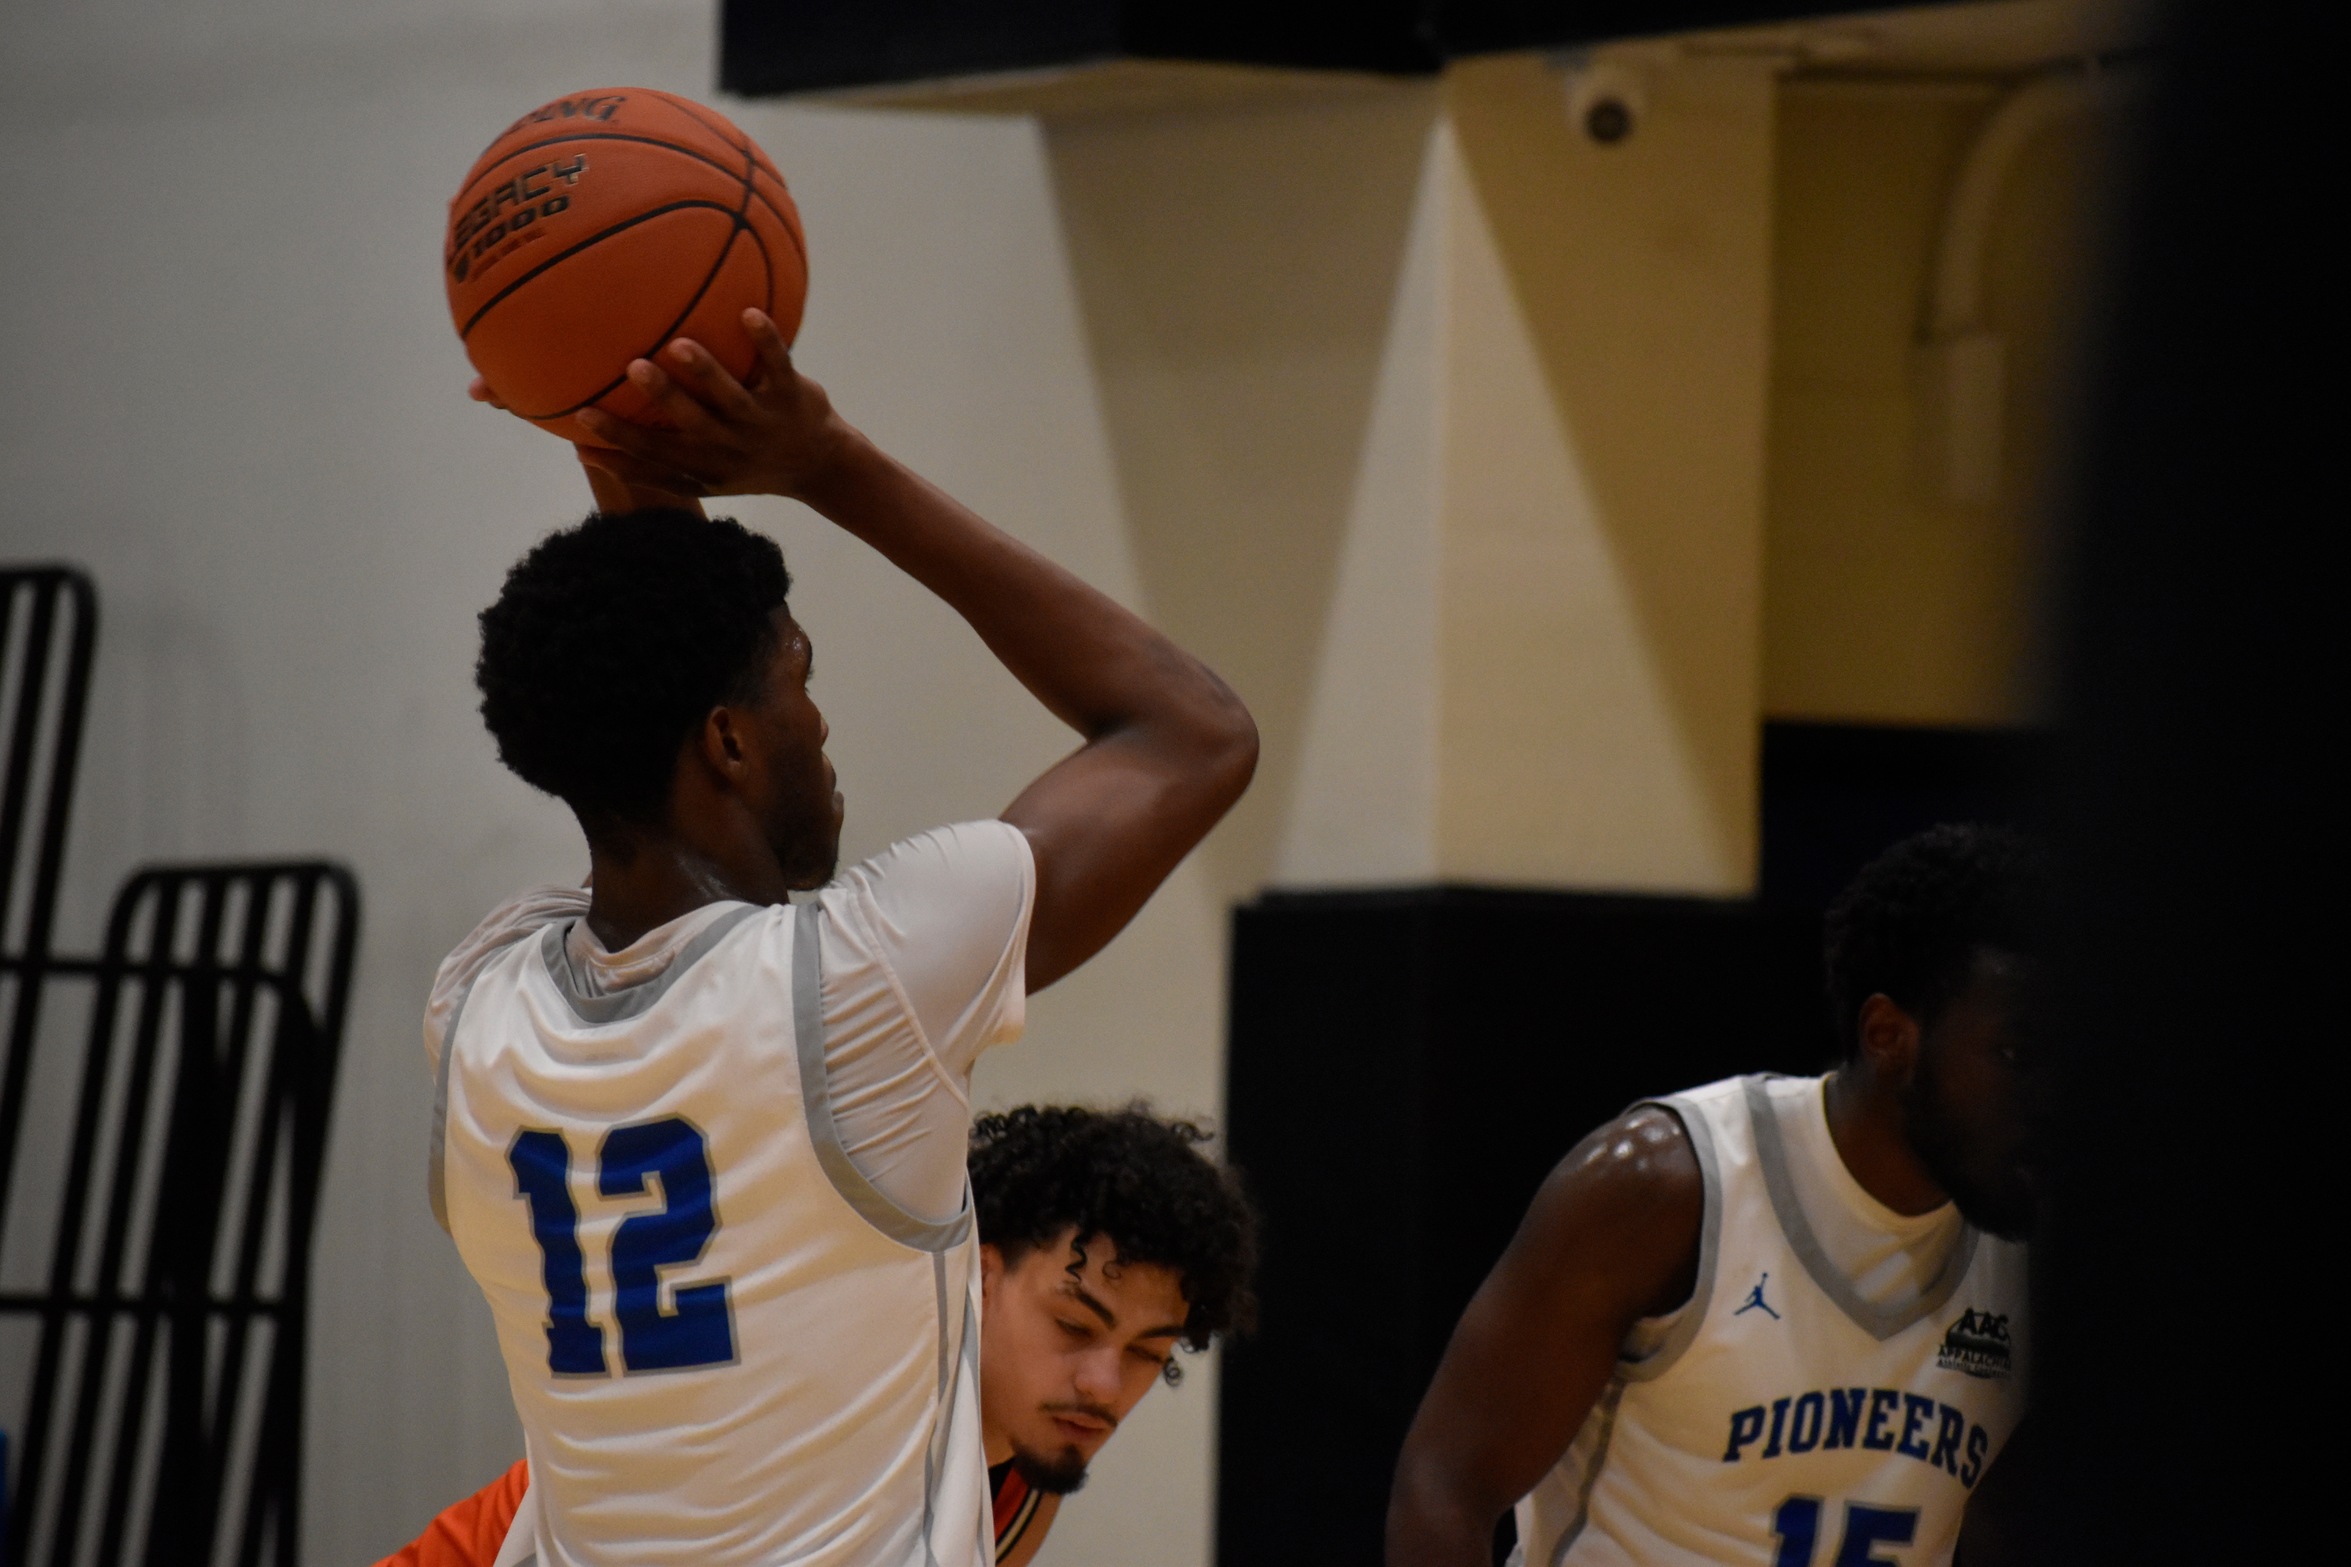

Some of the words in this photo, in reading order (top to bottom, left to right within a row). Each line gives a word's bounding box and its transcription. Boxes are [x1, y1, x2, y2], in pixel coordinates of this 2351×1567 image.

[449, 153, 591, 262] EGACY
[504, 1112, 740, 1379] 12
[1722, 1387, 1989, 1489] PIONEERS
